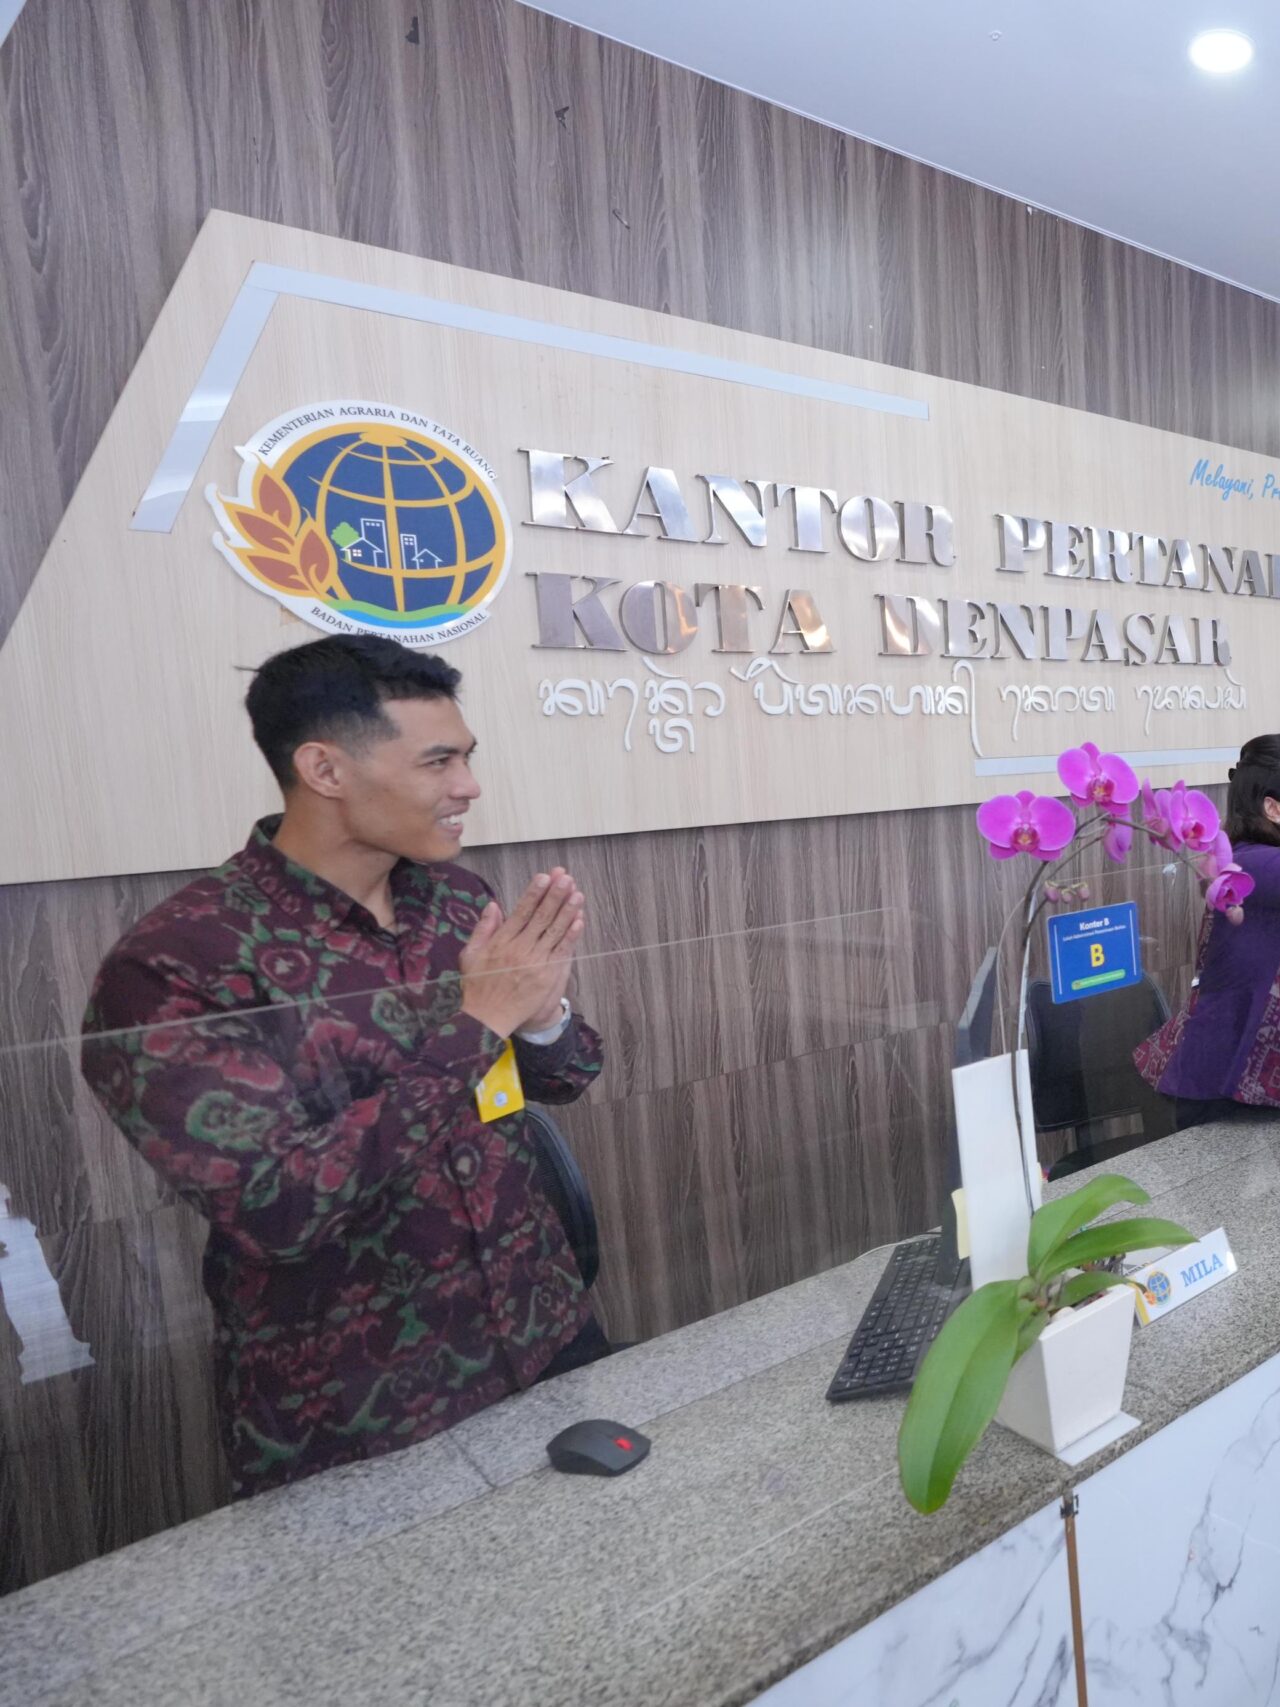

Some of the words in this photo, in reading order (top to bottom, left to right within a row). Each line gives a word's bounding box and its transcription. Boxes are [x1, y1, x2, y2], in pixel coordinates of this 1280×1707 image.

[259, 408, 335, 456] KEMENTERIAN
[339, 406, 396, 420] AGRARIA
[400, 412, 429, 428] DAN
[432, 423, 462, 447] TATA
[462, 444, 496, 480] RUANG
[1189, 458, 1254, 501] Melayani,
[517, 447, 957, 567] KANTOR
[310, 606, 354, 633] BADAN
[438, 612, 487, 641] NASIONAL
[525, 572, 838, 656] KOTA
[874, 594, 1233, 667] DENPASAR
[1079, 919, 1104, 931] Konter
[1090, 943, 1105, 968] B
[1180, 1253, 1224, 1288] MILA
